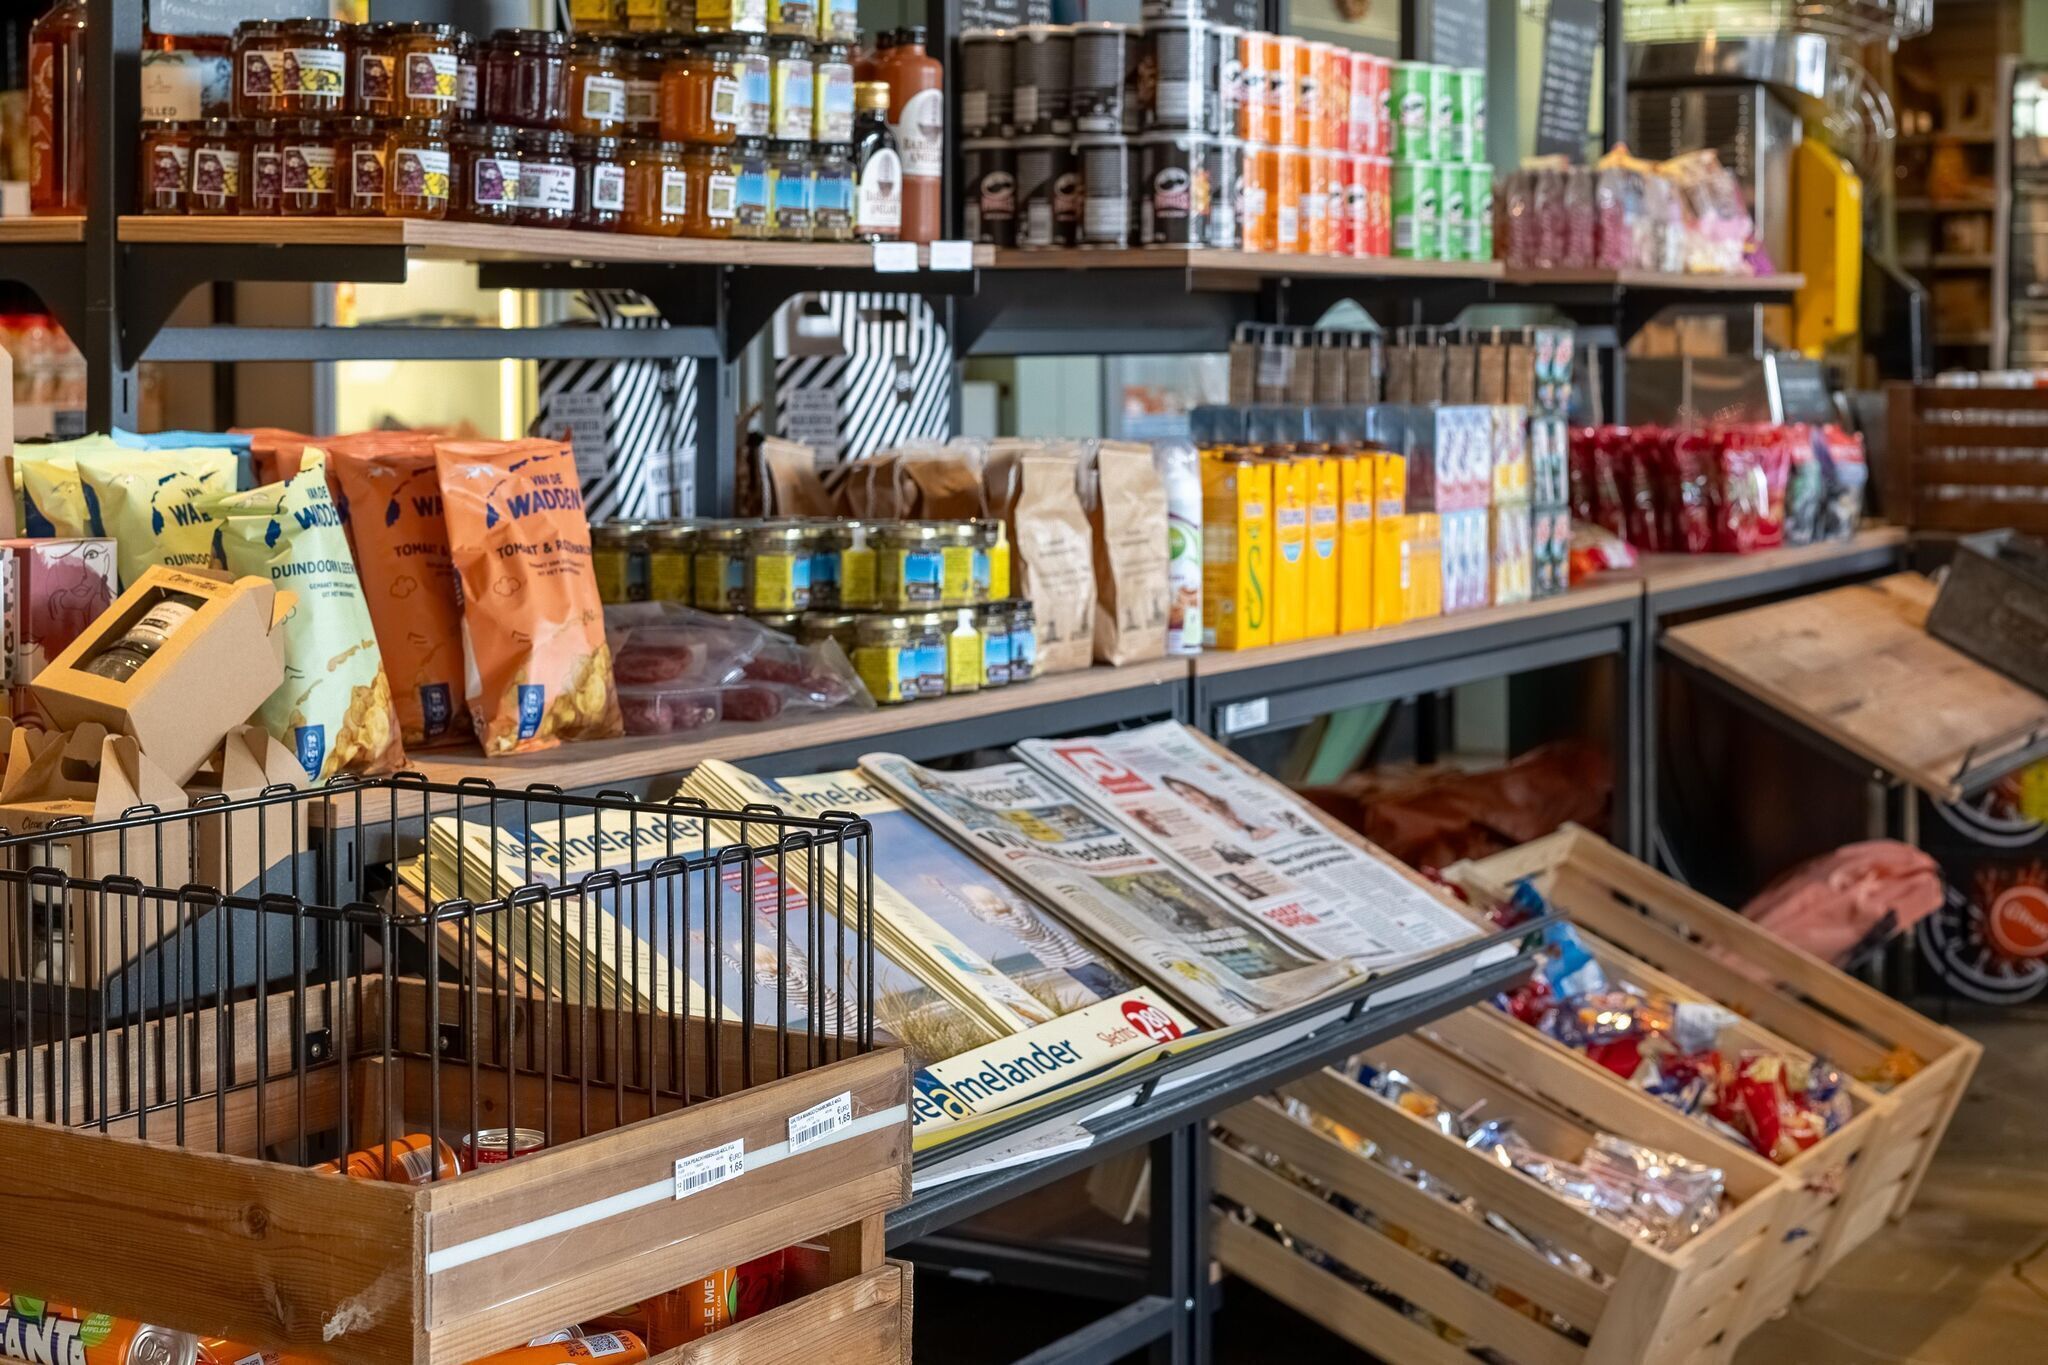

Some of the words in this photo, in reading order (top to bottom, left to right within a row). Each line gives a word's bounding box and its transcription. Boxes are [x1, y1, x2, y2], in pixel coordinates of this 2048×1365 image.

[530, 475, 549, 486] VAN
[551, 473, 563, 485] DE
[506, 488, 582, 520] WADDEN
[543, 542, 552, 553] &
[1096, 1026, 1139, 1048] Slechts
[838, 1113, 851, 1126] 1,65
[729, 1160, 743, 1174] 1,65
[704, 1279, 715, 1304] ME
